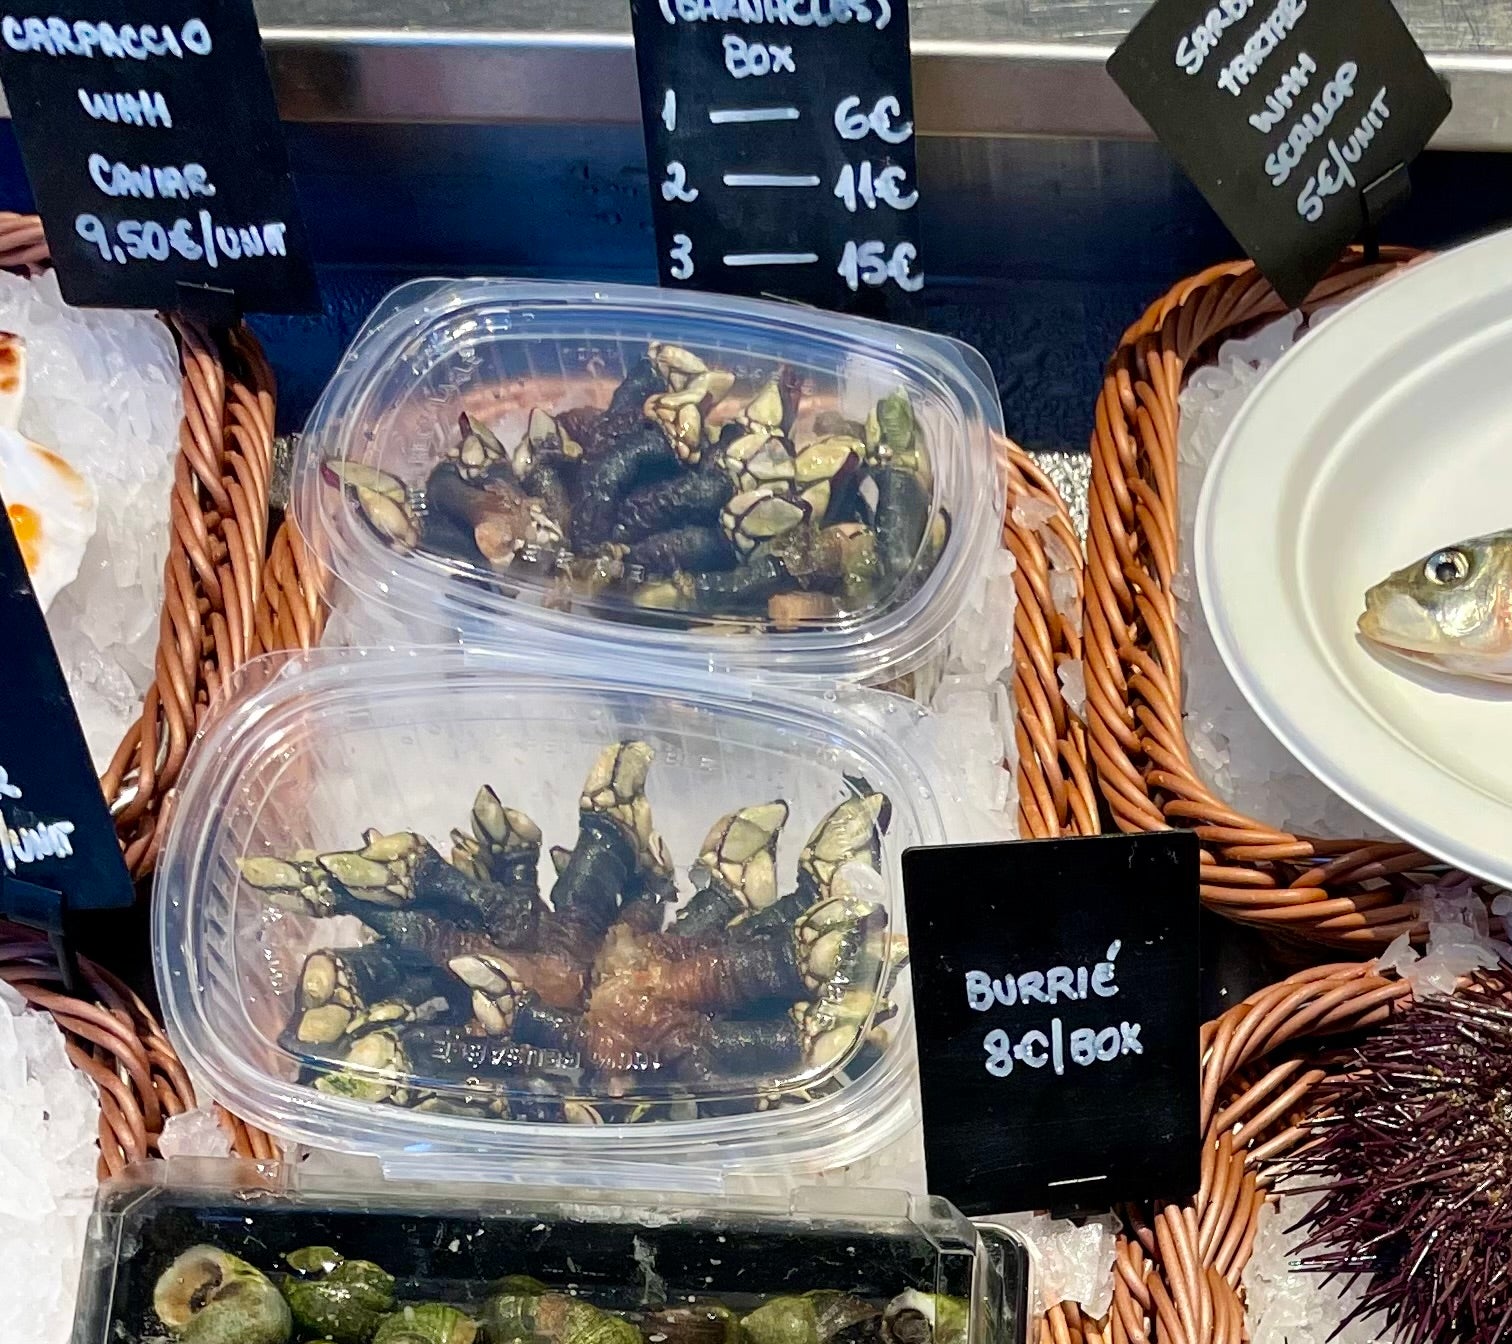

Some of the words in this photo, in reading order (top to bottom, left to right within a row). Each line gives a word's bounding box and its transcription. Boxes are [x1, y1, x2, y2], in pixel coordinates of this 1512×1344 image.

[2, 16, 212, 60] CARPACCIO
[722, 33, 796, 78] BOX
[1176, 0, 1254, 75] SARD
[661, 88, 676, 132] 1
[835, 95, 914, 144] 6€
[1265, 61, 1358, 187] SCALLOP
[661, 161, 699, 202] 2
[834, 160, 919, 212] 11€
[670, 233, 695, 280] 3
[837, 240, 925, 292] 15€
[966, 939, 1121, 1011] BURRIÉ
[984, 1017, 1143, 1077] 8€/BOX
